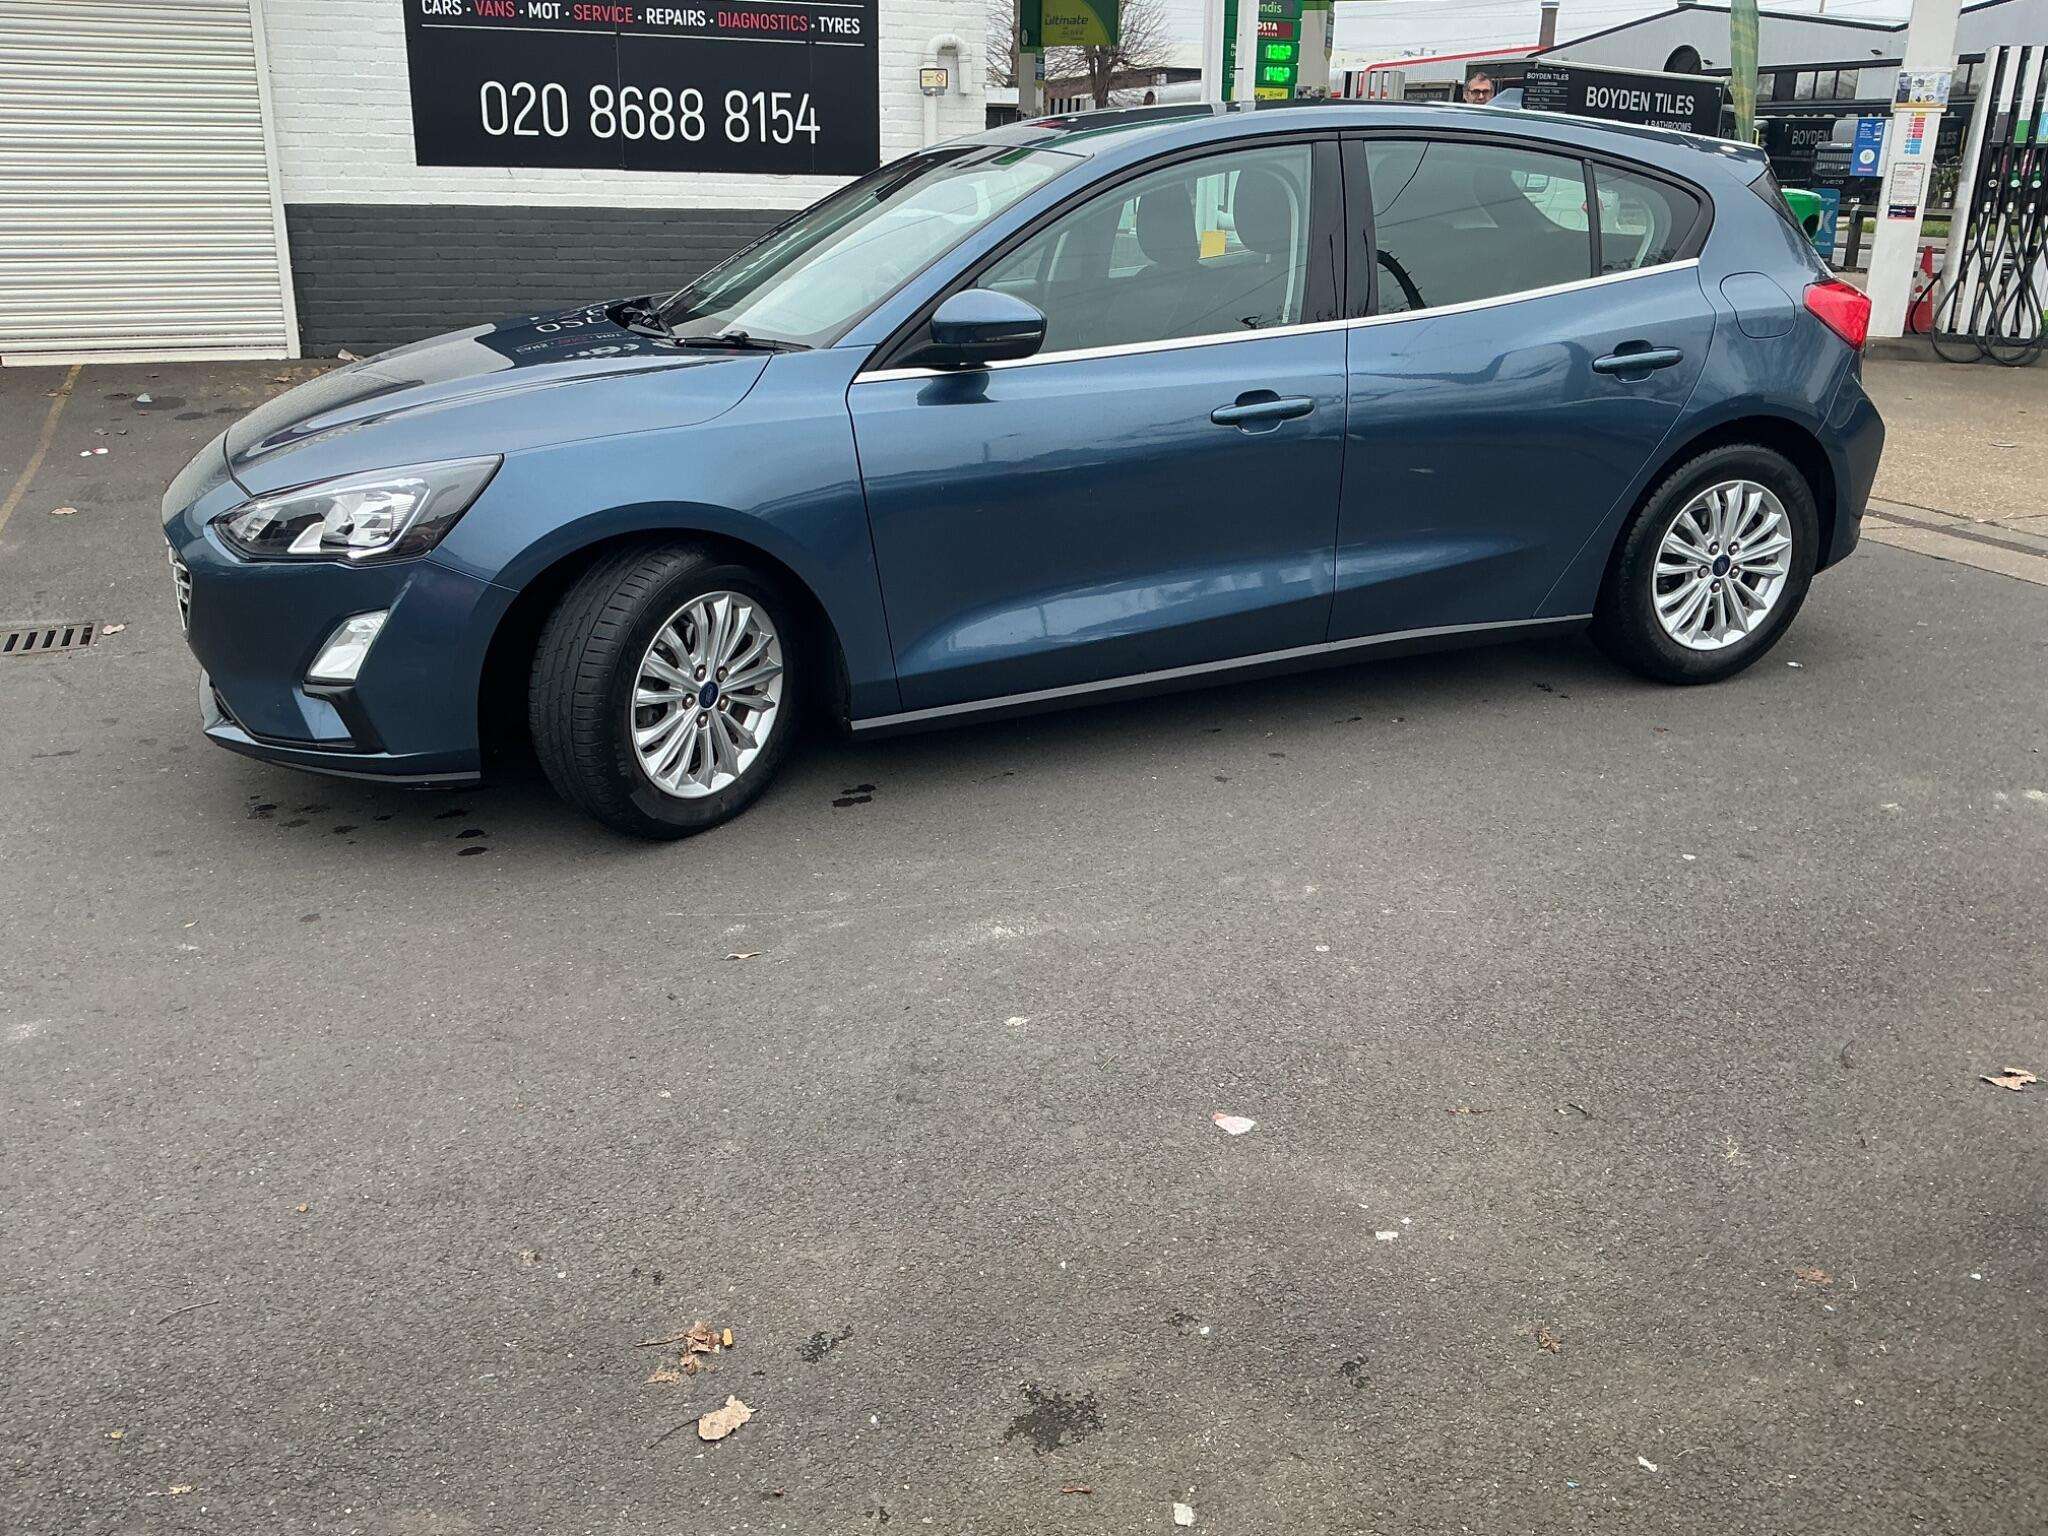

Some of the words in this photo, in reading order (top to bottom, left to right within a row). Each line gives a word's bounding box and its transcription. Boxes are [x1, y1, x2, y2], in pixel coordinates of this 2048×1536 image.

[421, 0, 462, 16] CARS
[475, 0, 515, 18] VANS
[528, 2, 561, 20] MOT
[573, 4, 634, 23] SERVICE
[646, 7, 706, 27] REPAIRS
[718, 11, 809, 32] DIAGNOSTICS
[819, 16, 861, 34] TYRES
[1258, 1, 1282, 14] ndis
[1257, 21, 1278, 31] OSTA
[1526, 72, 1552, 80] BOYDEN
[1552, 73, 1570, 81] TILES
[1585, 86, 1650, 113] BOYDEN
[1655, 93, 1694, 116] TILES
[479, 80, 569, 138] 020
[588, 84, 706, 142] 8688
[724, 89, 821, 145] 8154
